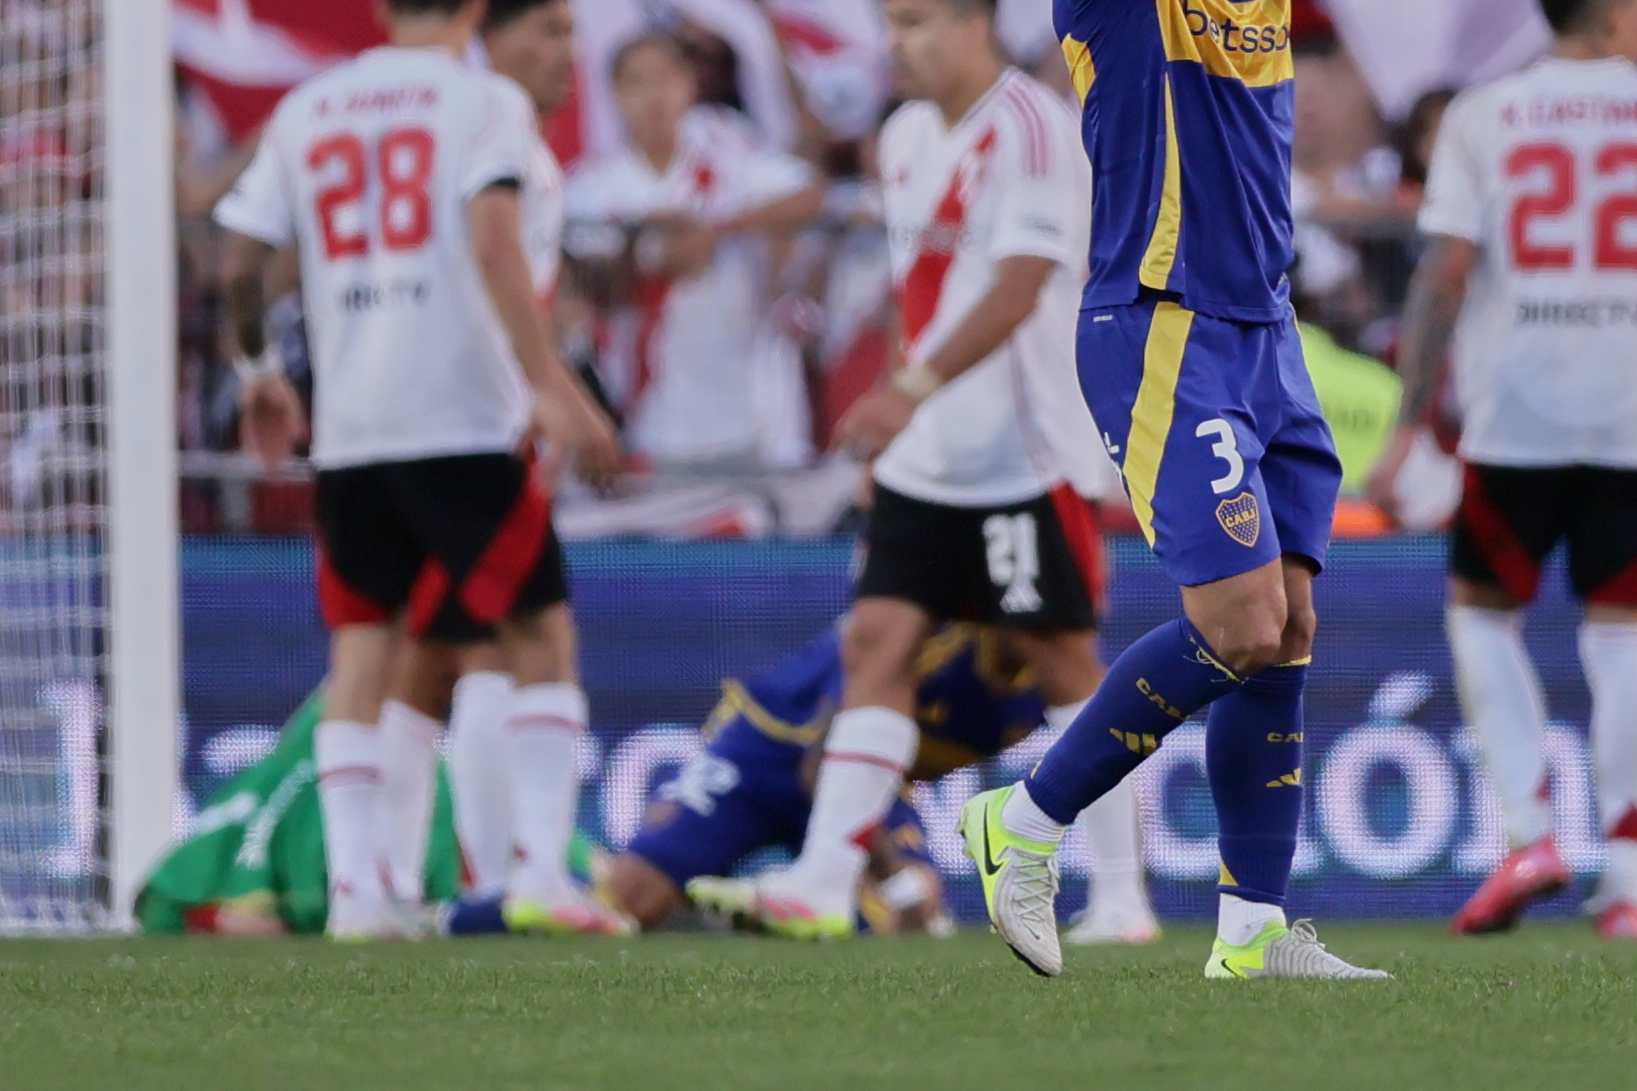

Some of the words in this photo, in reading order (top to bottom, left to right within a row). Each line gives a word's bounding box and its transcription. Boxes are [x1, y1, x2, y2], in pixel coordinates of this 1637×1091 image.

[1182, 0, 1291, 53] betsso
[308, 128, 436, 259] 28
[1196, 418, 1245, 494] 3
[982, 512, 1040, 587] 21
[1226, 511, 1256, 527] CABJ
